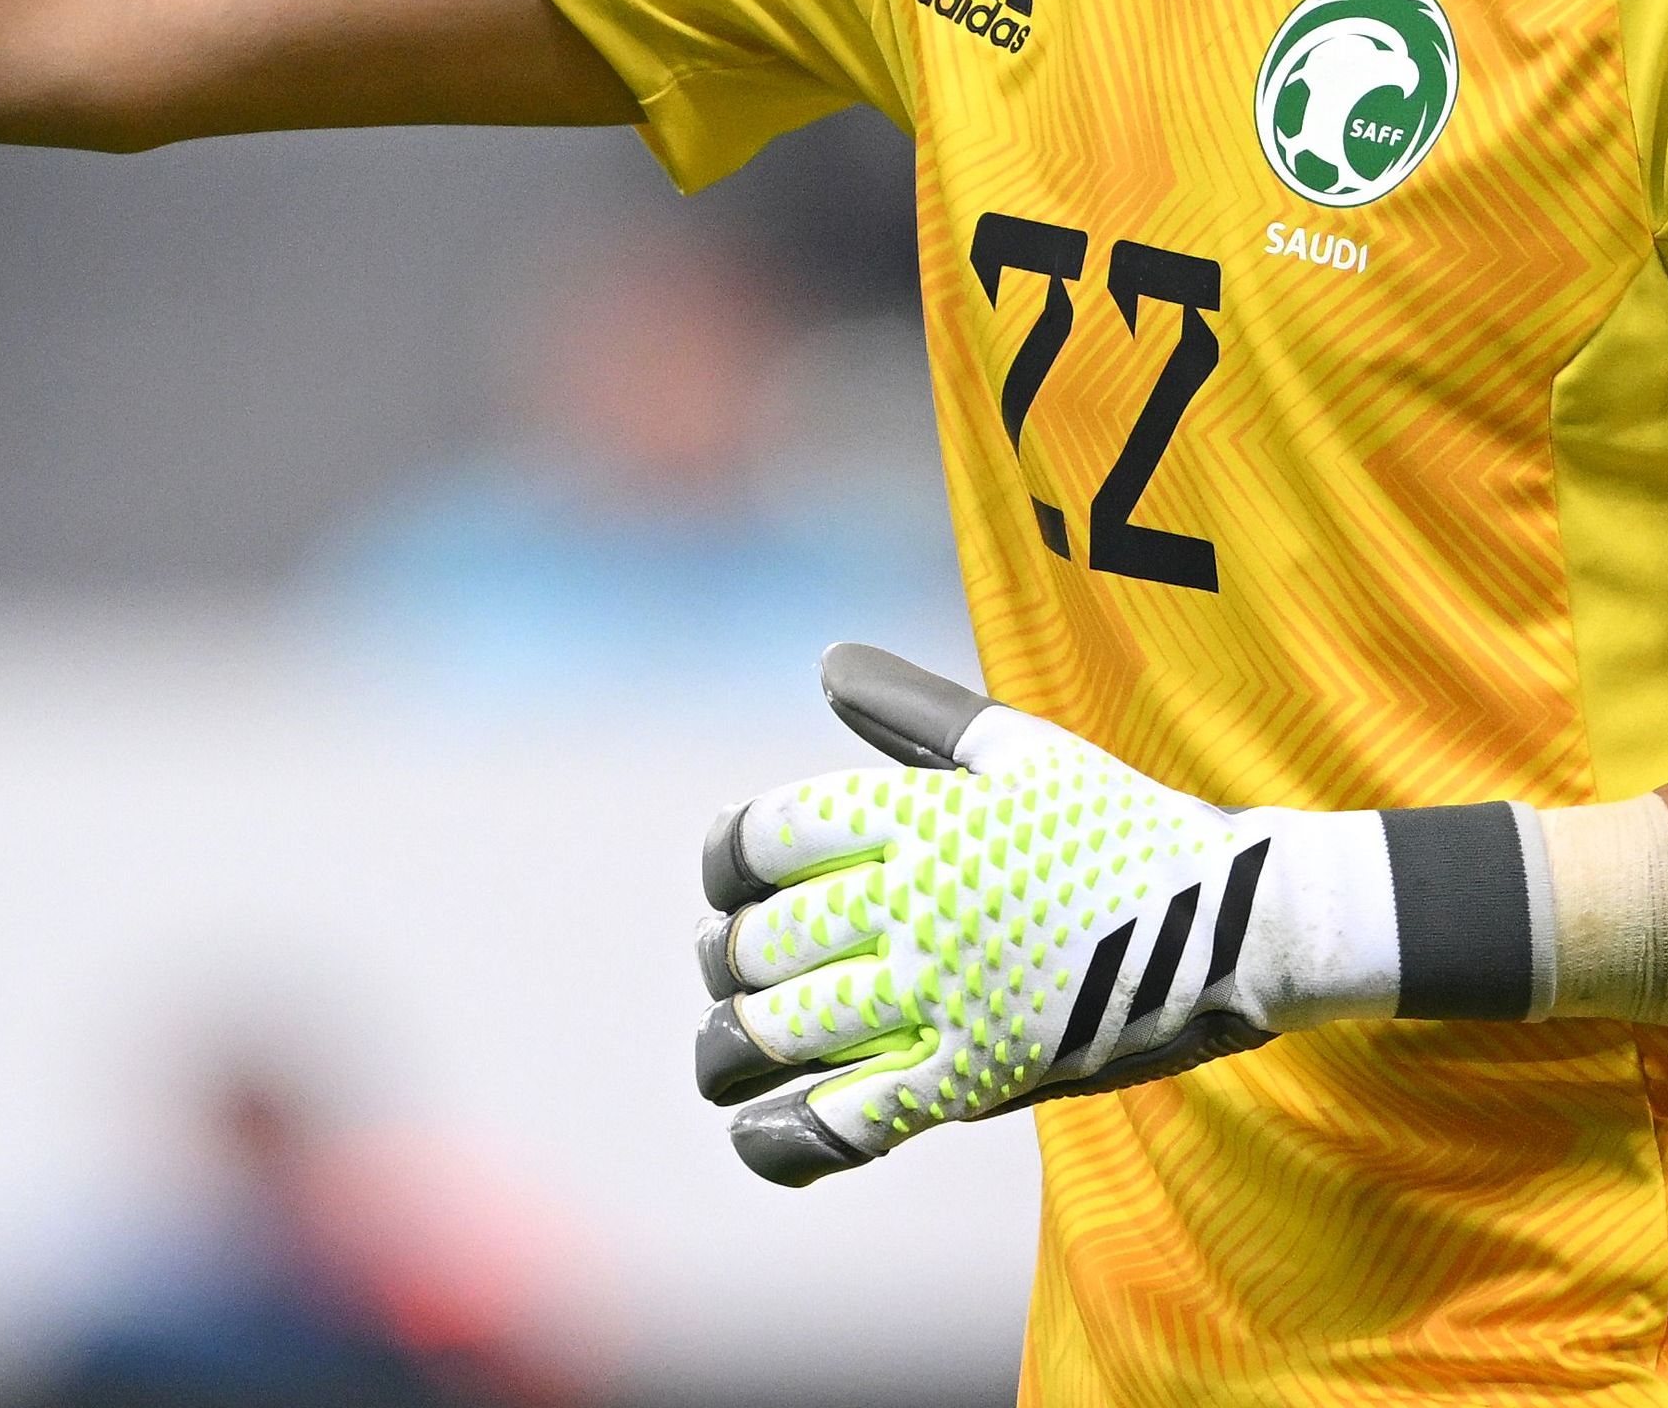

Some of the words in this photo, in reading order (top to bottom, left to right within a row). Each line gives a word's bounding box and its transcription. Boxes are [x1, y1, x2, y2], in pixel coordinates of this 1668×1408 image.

[1349, 118, 1404, 146] SAFF
[1263, 221, 1368, 274] SAUDI
[969, 211, 1221, 594] 22
